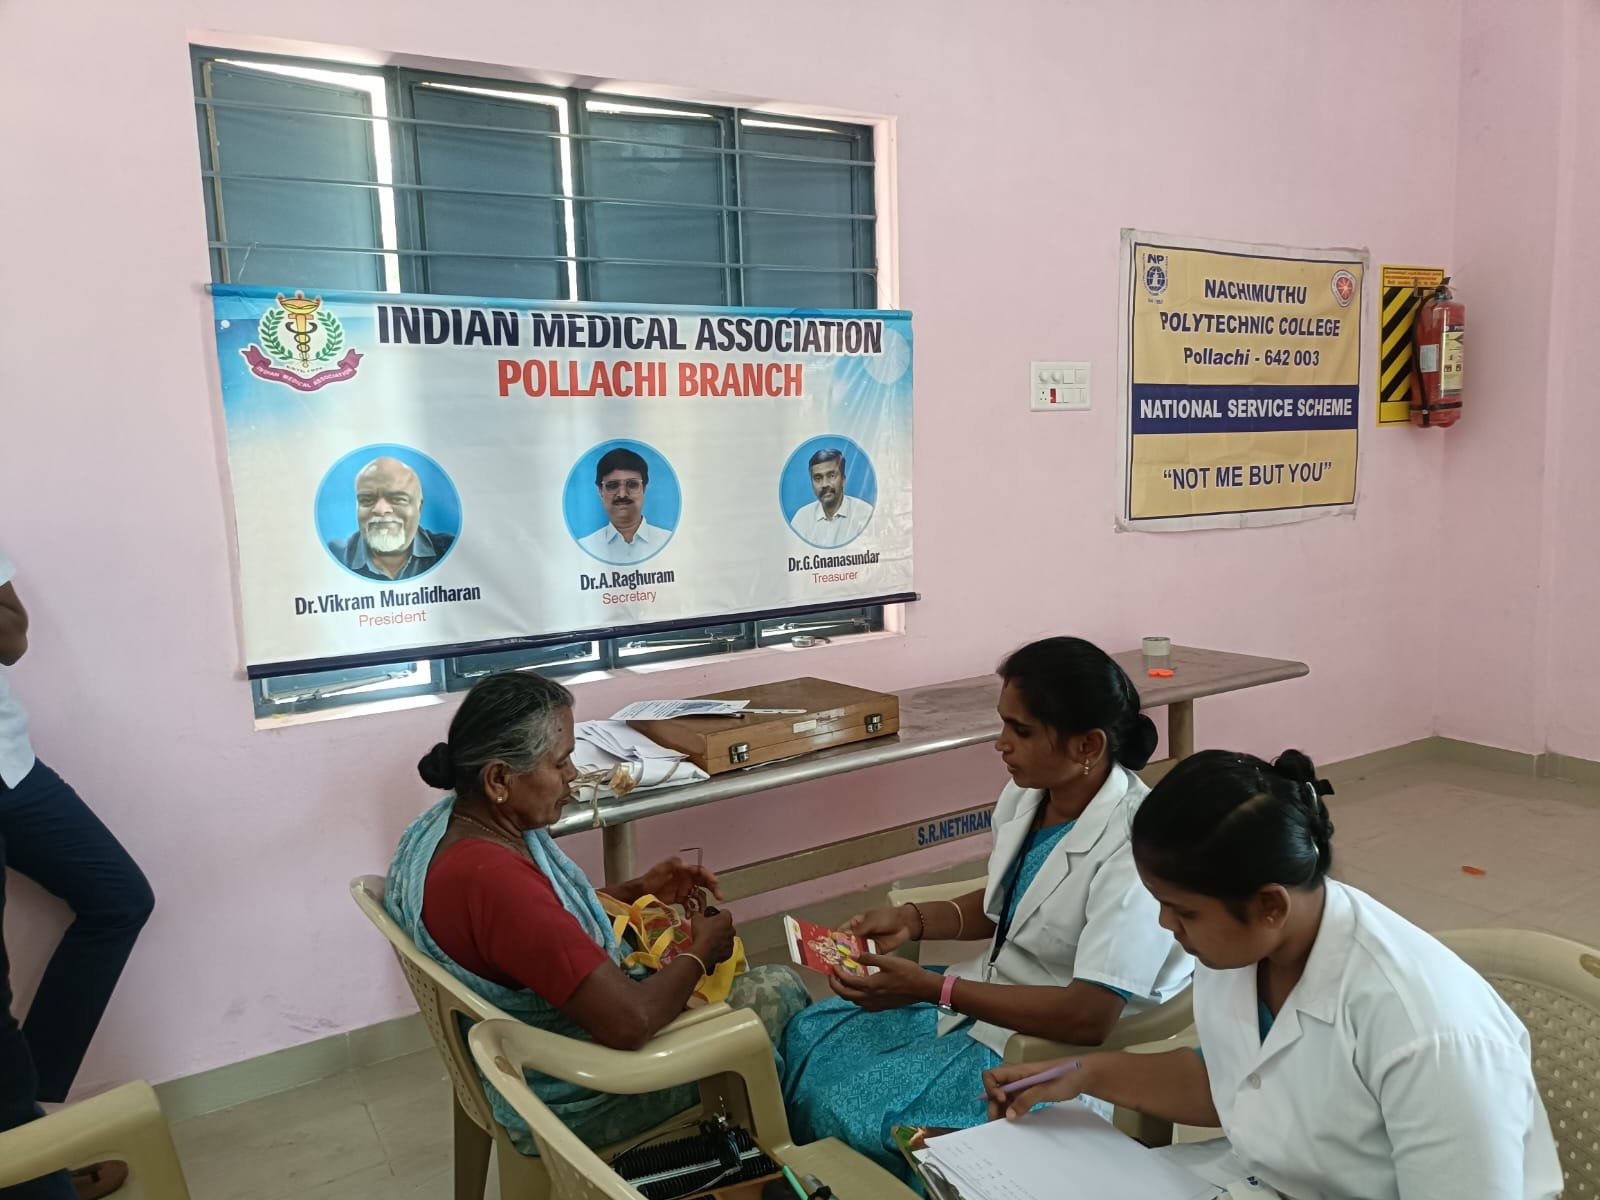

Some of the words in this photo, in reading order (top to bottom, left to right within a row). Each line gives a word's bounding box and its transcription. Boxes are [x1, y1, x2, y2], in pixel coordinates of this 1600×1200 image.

[1147, 254, 1165, 264] NP
[1204, 279, 1307, 304] NACHIMUTHU
[377, 305, 519, 346] INDIAN
[531, 312, 686, 350] MEDICAL
[695, 317, 882, 353] ASSOCIATION
[1160, 311, 1275, 334] POLYTECHNIC
[1279, 316, 1341, 336] COLLEGE
[1184, 347, 1250, 365] Pollachi
[1264, 349, 1290, 366] 642
[1294, 350, 1320, 366] 003
[498, 359, 667, 397] POLLACHI
[678, 362, 803, 397] BRANCH
[1140, 399, 1222, 419] NATIONAL
[1227, 398, 1293, 418] SERVICE
[1297, 398, 1352, 416] SCHEME
[1215, 466, 1243, 487] ME
[1249, 464, 1285, 485] BUT
[788, 549, 880, 572] Dr.G.Gnanasundar
[580, 569, 675, 590] Dr.A.Raghuram
[812, 571, 858, 583] Treasurer
[295, 593, 375, 615] Dr.Vikram
[380, 585, 481, 607] Muralidharan
[602, 590, 656, 604] Secretary
[359, 610, 427, 627] President
